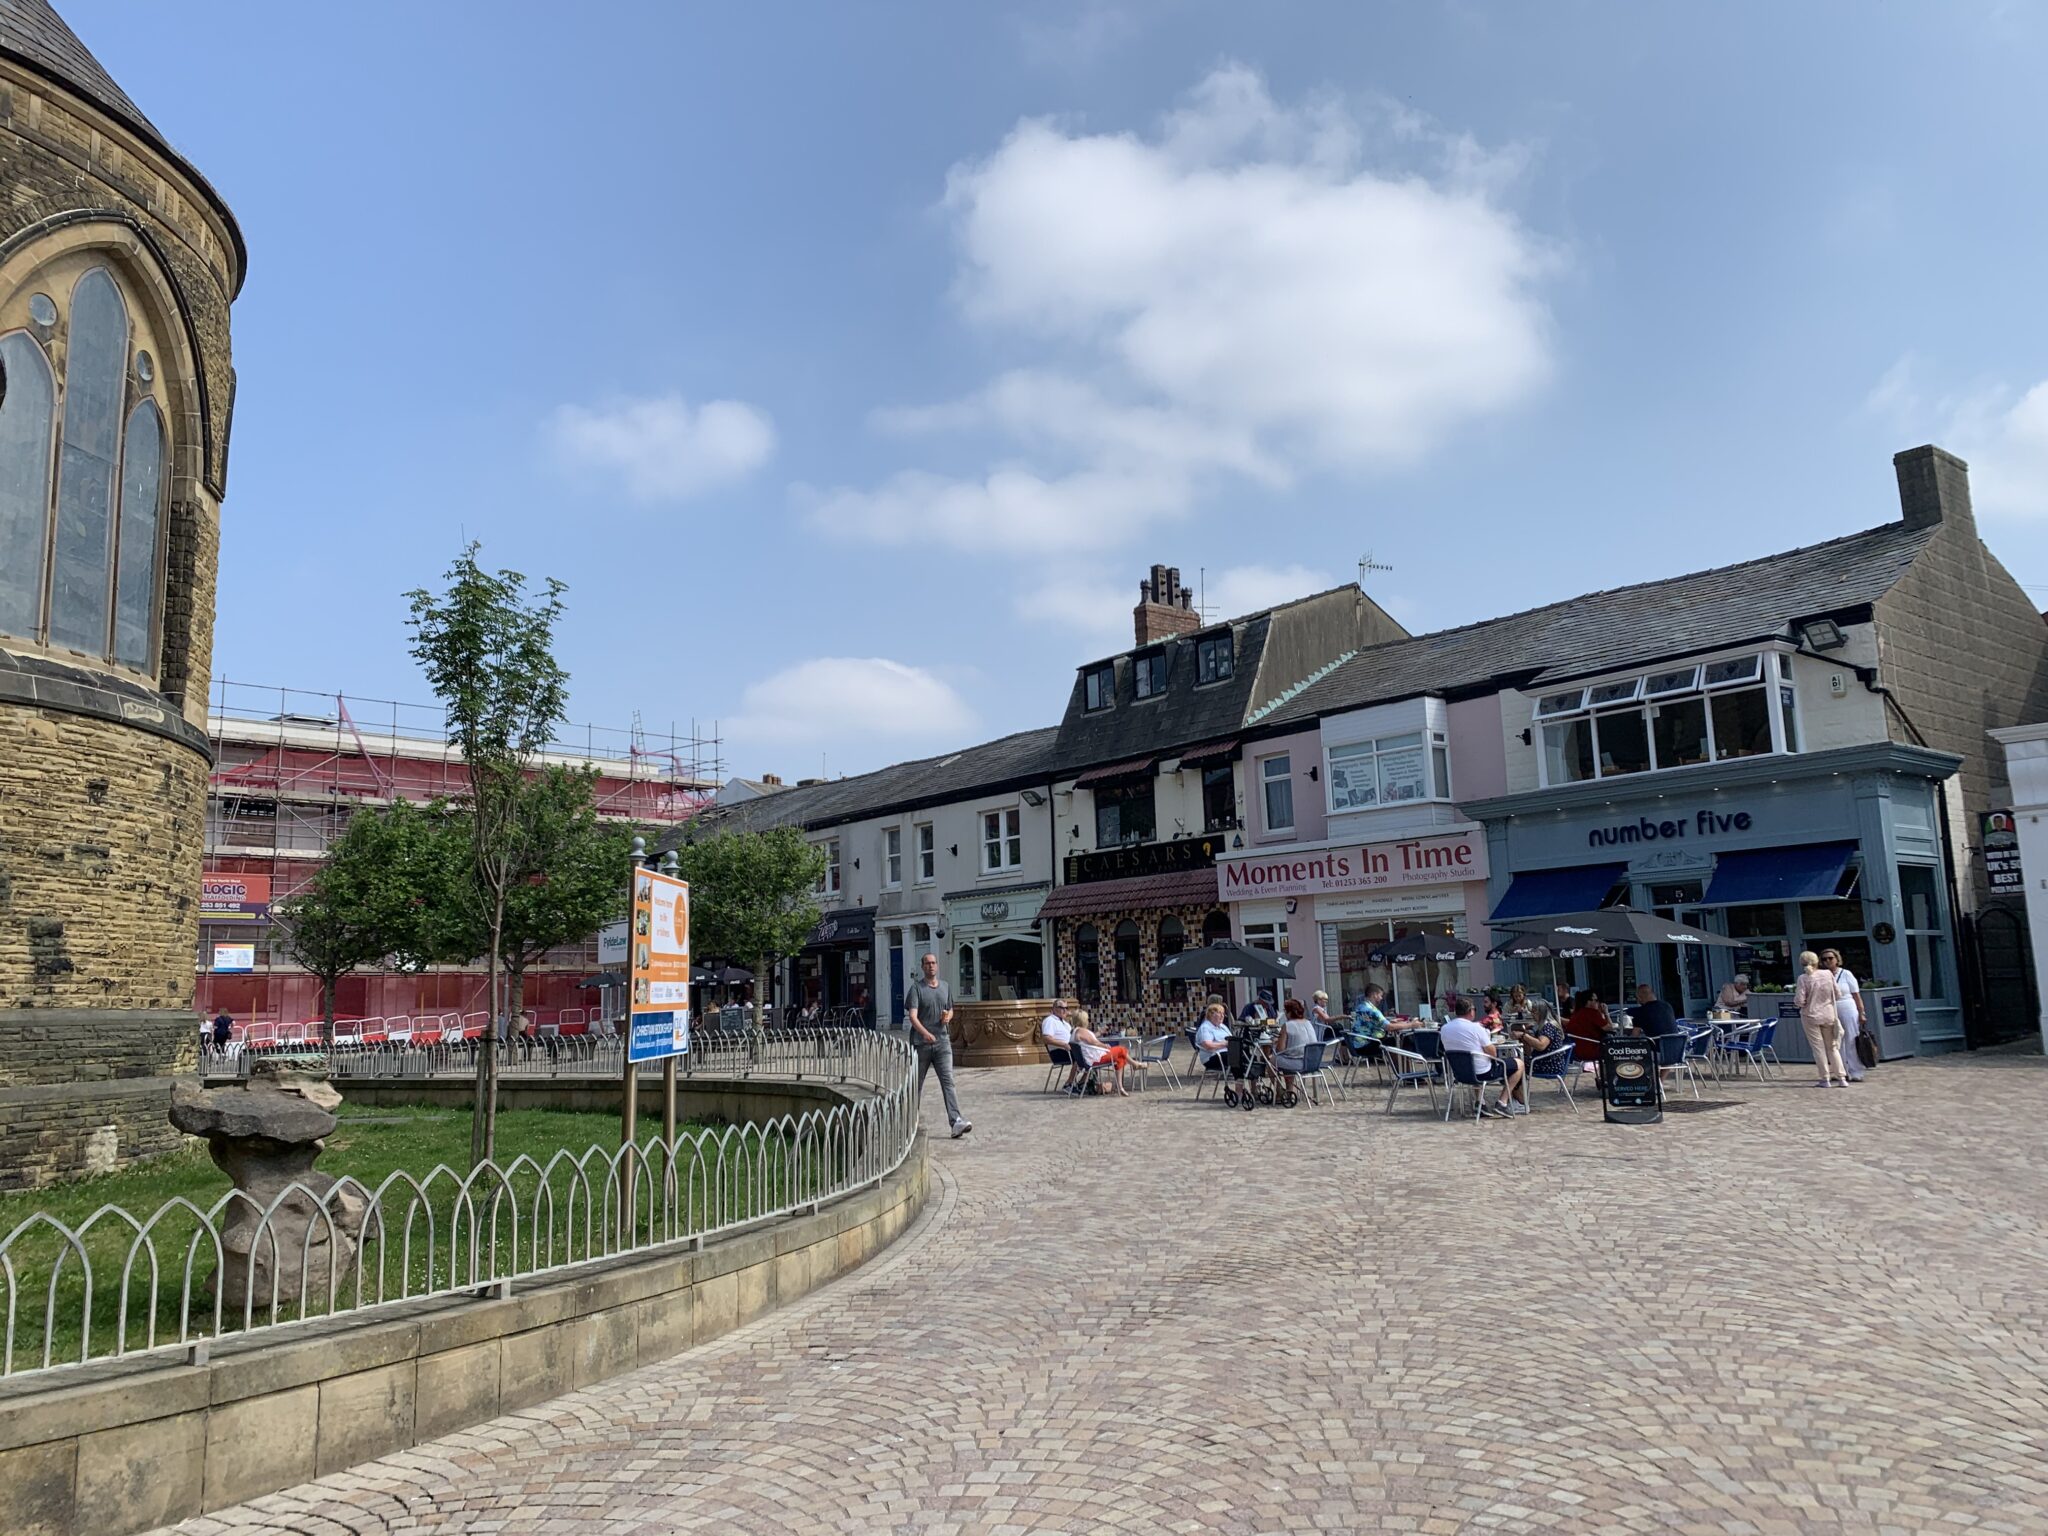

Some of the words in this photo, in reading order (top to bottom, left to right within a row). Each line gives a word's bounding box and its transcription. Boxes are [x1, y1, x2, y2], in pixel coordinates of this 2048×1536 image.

[1588, 816, 1688, 847] number
[1696, 810, 1752, 836] five
[1083, 844, 1191, 872] CAESARS
[1226, 853, 1350, 887] Moments
[1362, 848, 1389, 873] In
[1396, 841, 1472, 870] Time
[1987, 861, 2009, 871] UK's
[1402, 869, 1448, 881] Photography
[1450, 868, 1476, 877] Studio
[1994, 873, 2019, 883] BEST
[1322, 879, 1333, 888] Tel:
[1334, 878, 1357, 888] 01253
[1358, 876, 1372, 885] 365
[1374, 875, 1388, 884] 200
[203, 884, 246, 895] LOGIC
[1226, 888, 1254, 897] Wedding
[1261, 886, 1278, 894] Event
[1279, 884, 1307, 892] Planning
[1675, 890, 1684, 898] 5
[1205, 967, 1243, 975] Coca-Cola
[1608, 1047, 1624, 1055] Cool
[1625, 1047, 1648, 1055] Beans
